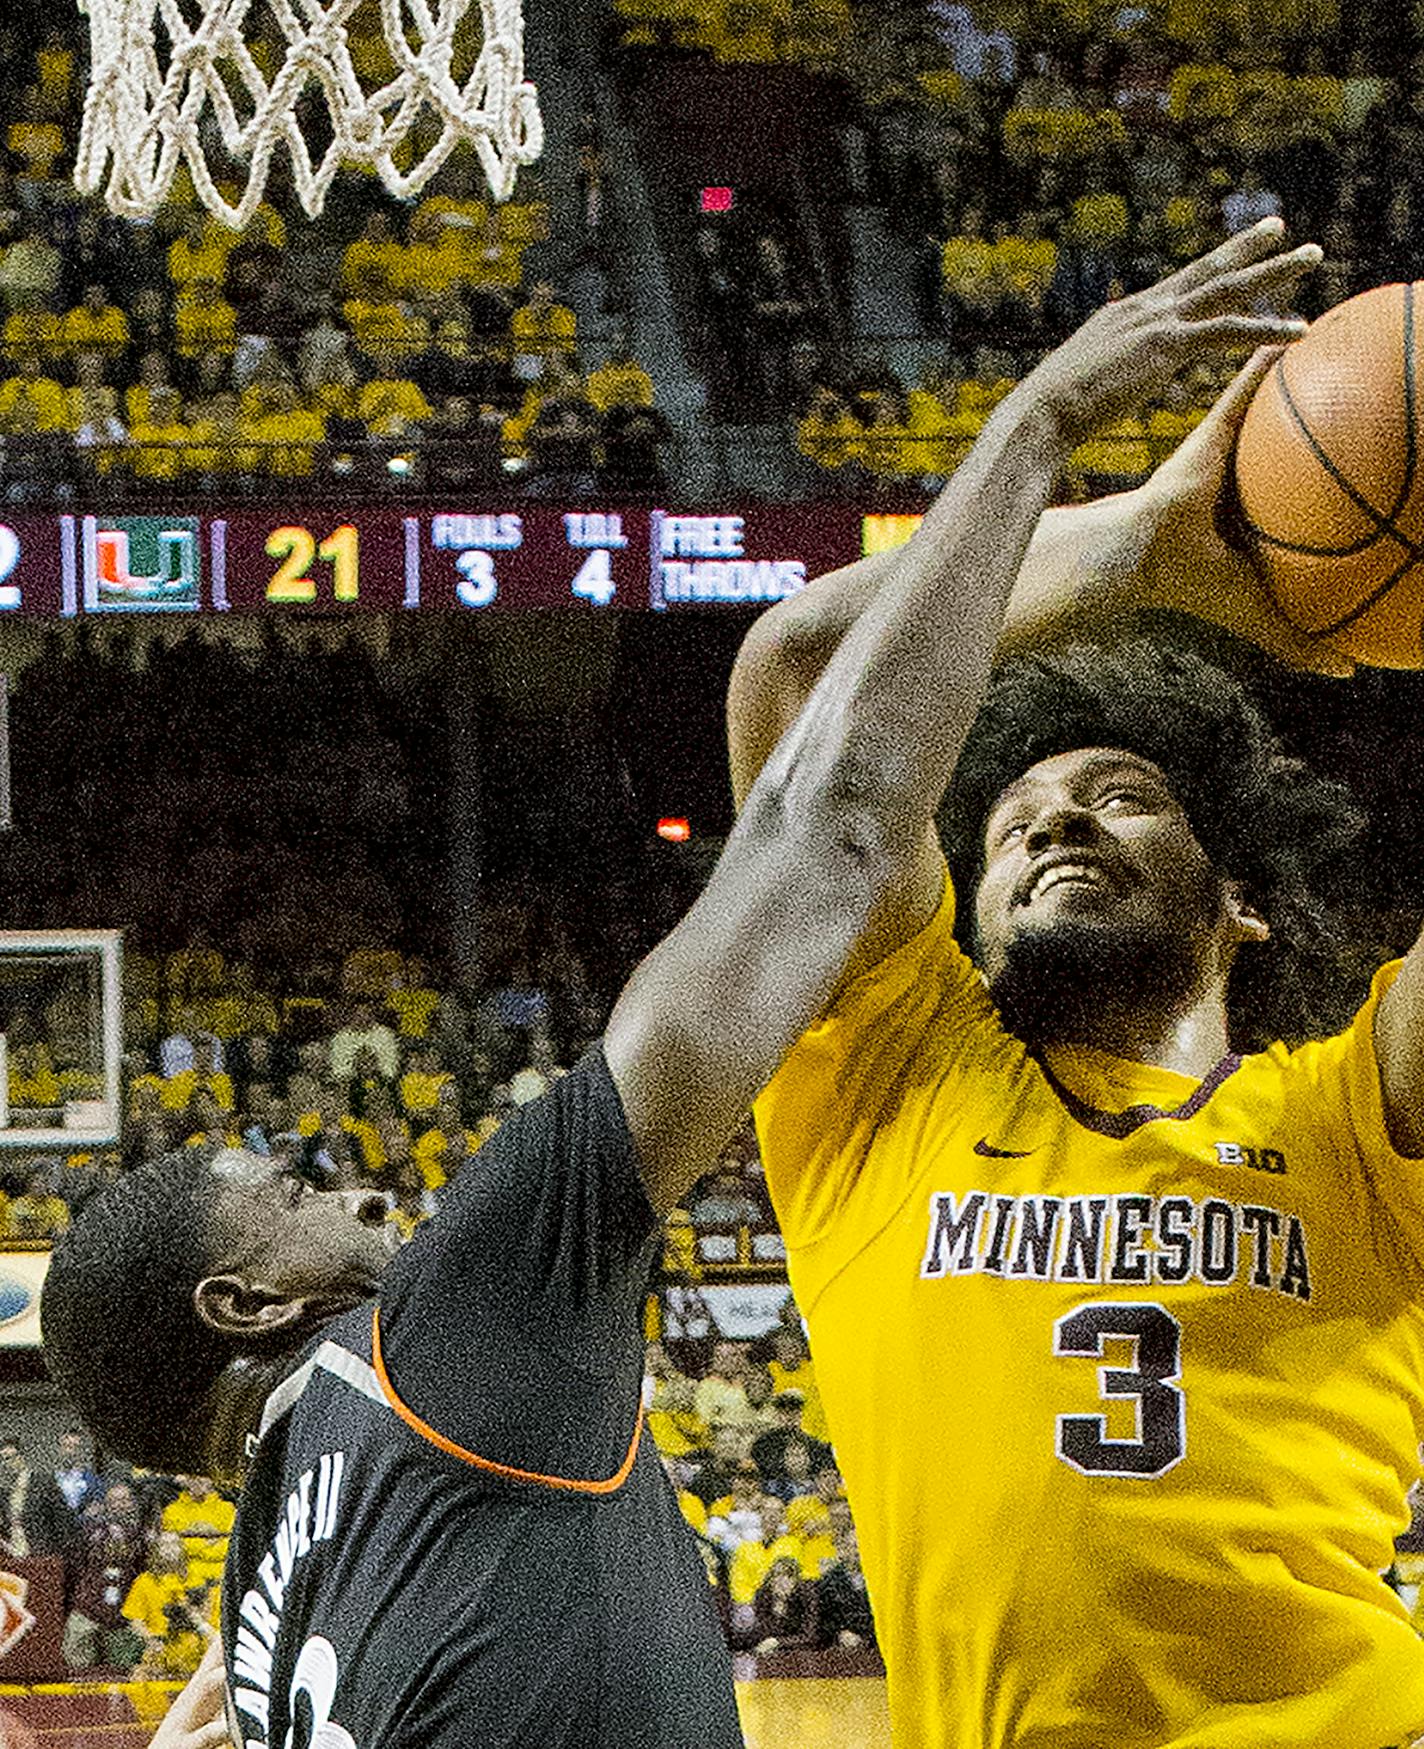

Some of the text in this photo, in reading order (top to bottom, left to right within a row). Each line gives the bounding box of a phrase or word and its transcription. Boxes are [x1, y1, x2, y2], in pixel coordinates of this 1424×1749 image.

[264, 524, 360, 602] 21
[662, 514, 745, 558] FREE
[455, 550, 498, 608] 3
[571, 549, 617, 606] 4
[662, 560, 807, 603] THROWS
[920, 1190, 1312, 1302] MINNESOTA
[1053, 1300, 1186, 1479] 3
